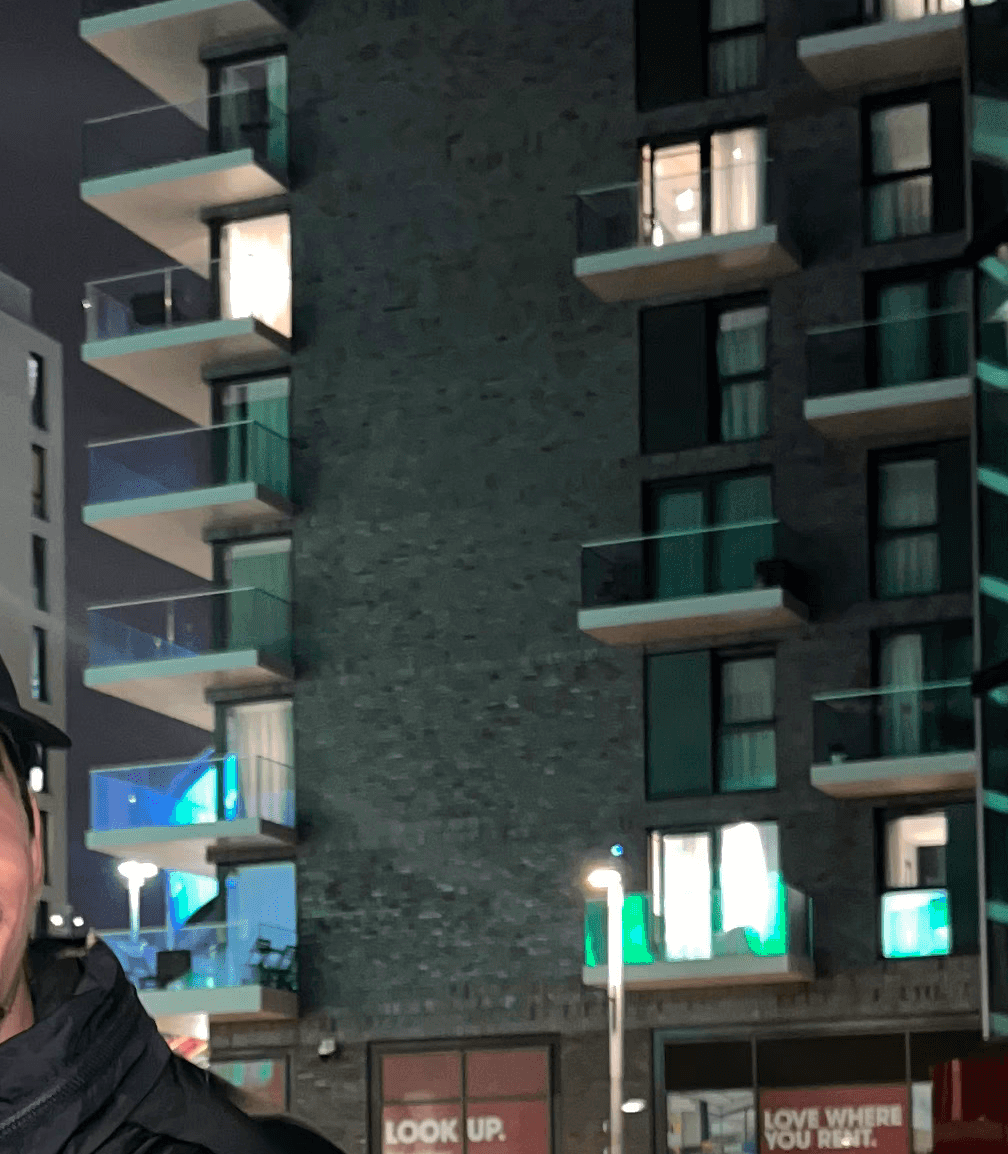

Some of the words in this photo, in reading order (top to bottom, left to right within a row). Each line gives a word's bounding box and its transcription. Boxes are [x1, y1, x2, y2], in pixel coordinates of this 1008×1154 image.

[764, 1107, 819, 1130] LOVE
[824, 1104, 902, 1127] WHERE
[385, 1118, 459, 1145] LOOK
[466, 1116, 506, 1142] UP.
[765, 1129, 811, 1150] YOU
